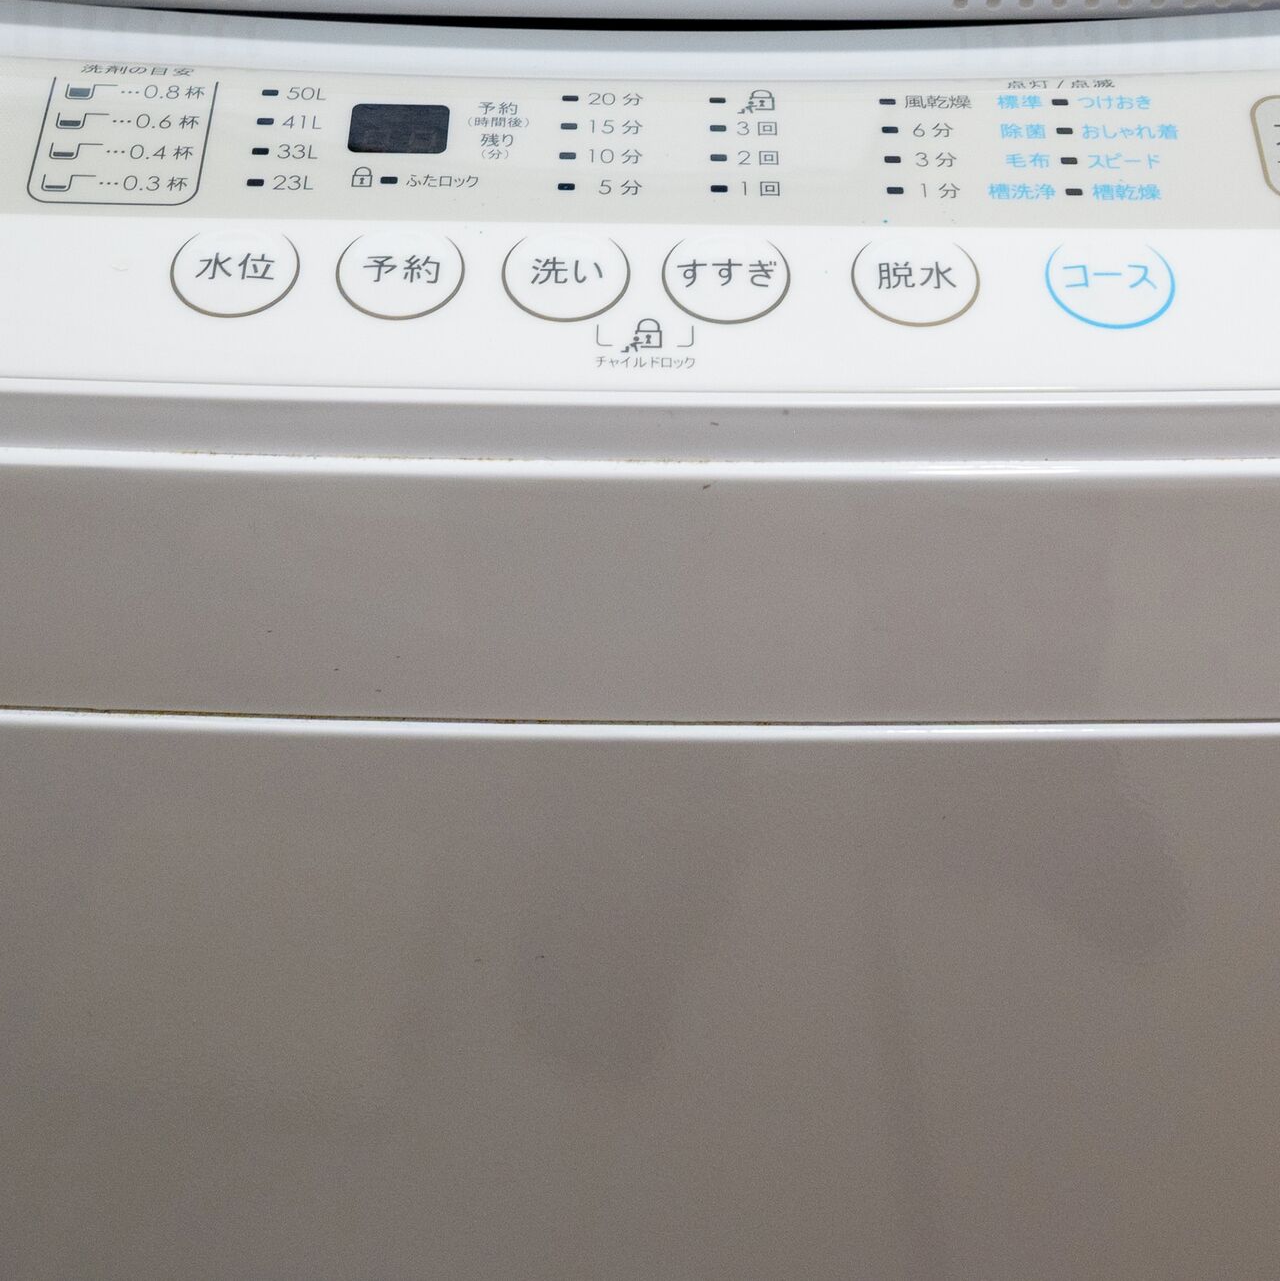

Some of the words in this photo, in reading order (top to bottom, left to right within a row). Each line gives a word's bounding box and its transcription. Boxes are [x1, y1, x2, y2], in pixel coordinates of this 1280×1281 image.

[80, 63, 196, 78] 洗剤の目安
[286, 86, 327, 101] 50L
[477, 101, 519, 116] 予約
[904, 94, 973, 110] 風乾燥
[996, 94, 1043, 110] 標準
[1076, 94, 1153, 110] つけおき
[281, 115, 323, 130] 41L
[1000, 124, 1047, 140] 除菌
[1081, 123, 1179, 140] おしゃれ着
[480, 133, 515, 147] 残り
[276, 144, 319, 160] 33L
[1005, 153, 1051, 169] 毛布
[1087, 152, 1161, 170] スピード
[272, 174, 314, 191] 23L
[405, 173, 480, 188] ふたロック
[988, 183, 1056, 201] 槽洗浄
[1092, 183, 1162, 202] 槽乾燥
[195, 252, 276, 282] 水位
[362, 254, 441, 285] 予約
[530, 256, 604, 288] 洗い
[676, 257, 778, 289] すすぎ
[876, 259, 958, 291] 脱水
[1062, 263, 1159, 292] コース
[595, 354, 696, 370] チャイルドロック
